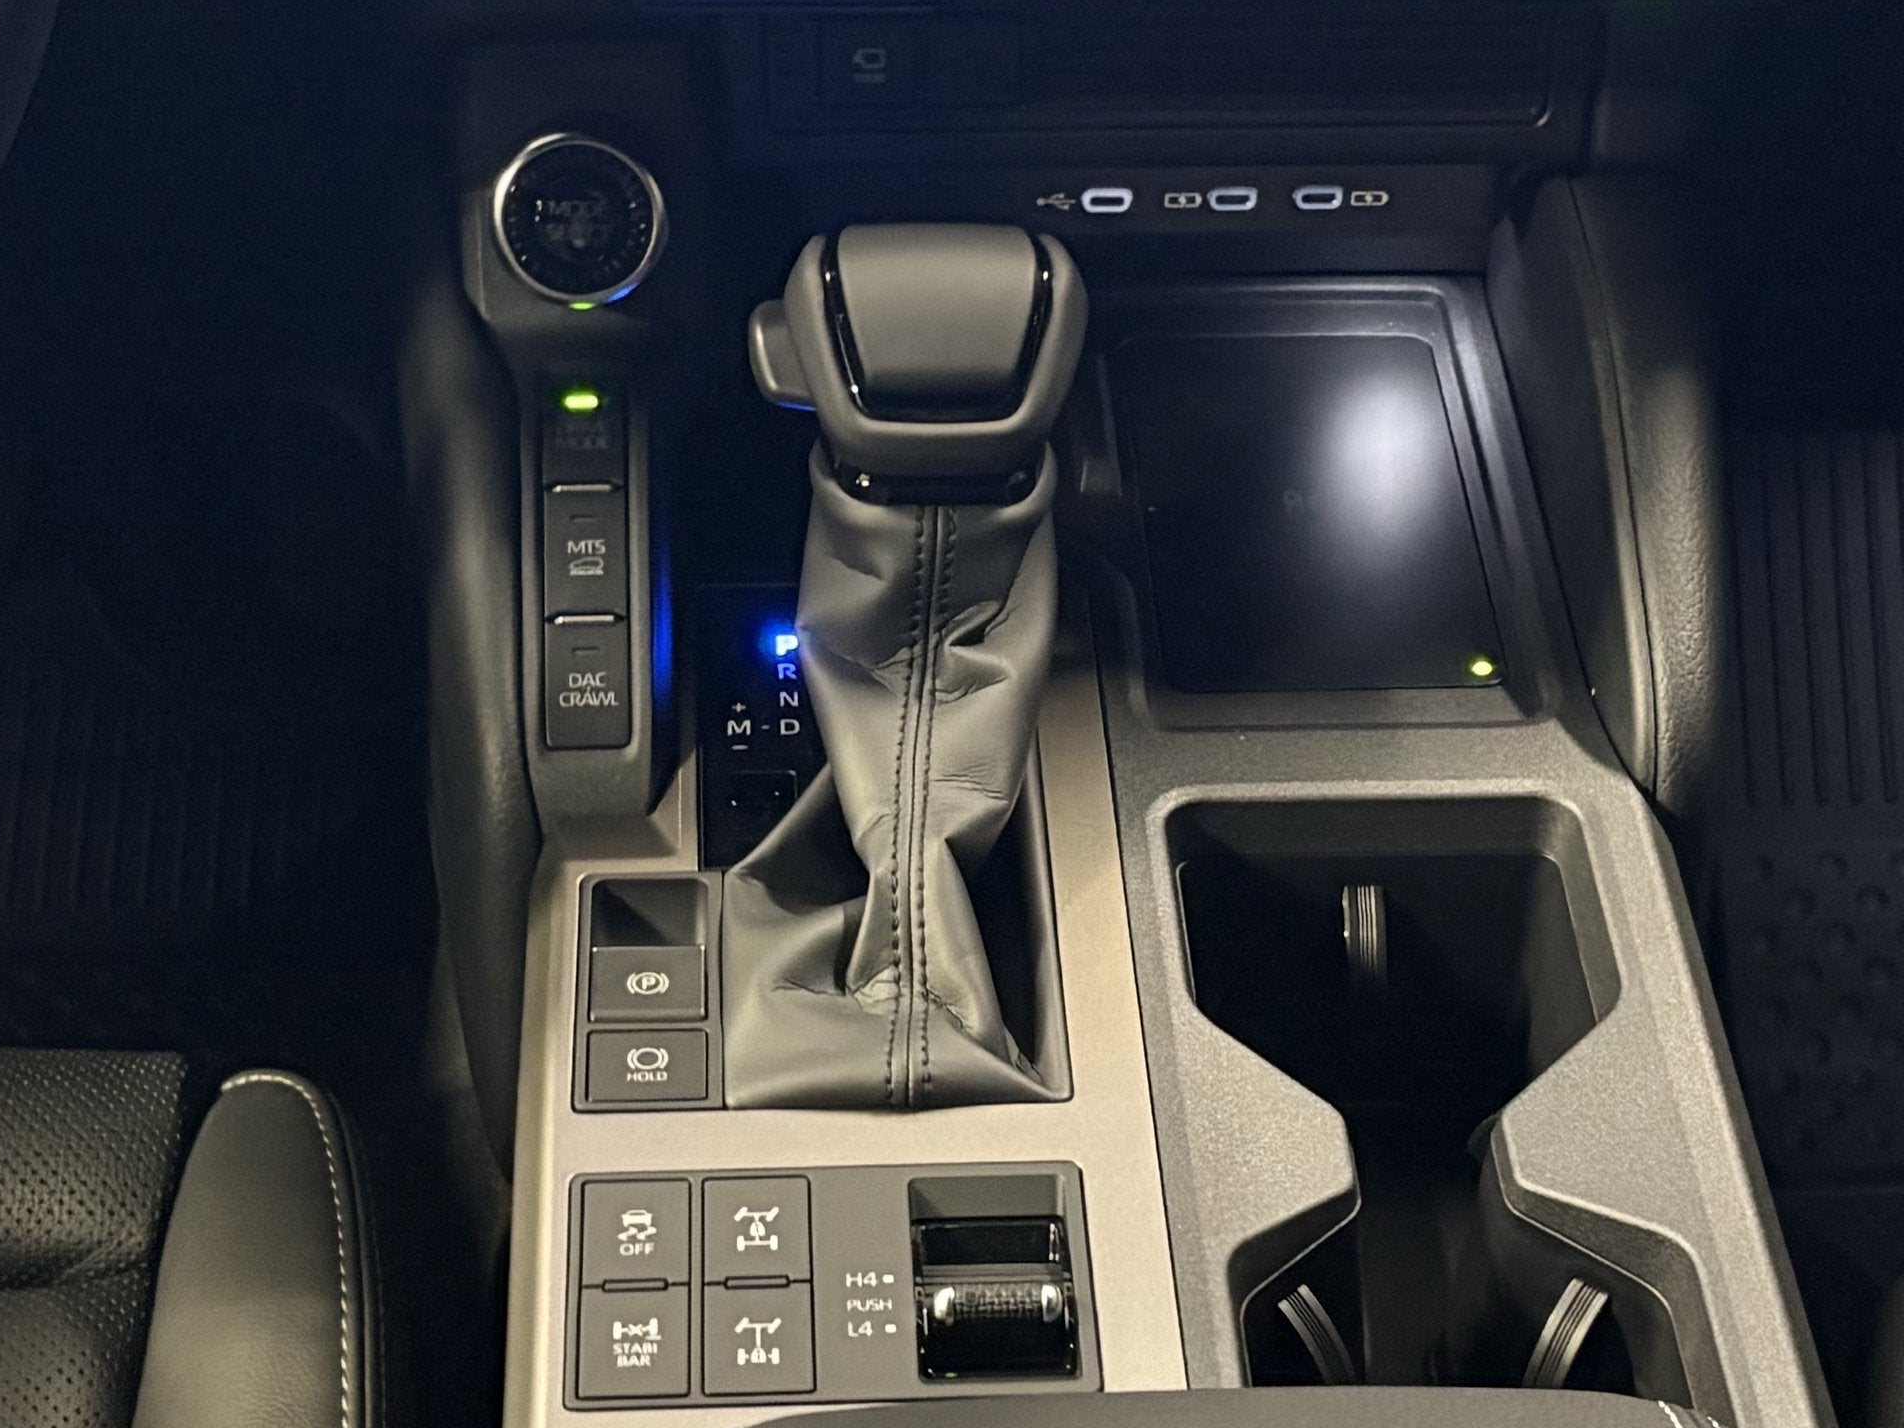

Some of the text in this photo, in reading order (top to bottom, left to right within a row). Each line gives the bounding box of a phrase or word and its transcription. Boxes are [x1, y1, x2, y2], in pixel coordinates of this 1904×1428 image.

[566, 539, 606, 556] MTS
[776, 634, 799, 657] P
[777, 662, 798, 680] R
[568, 671, 606, 689] DAC
[558, 690, 619, 707] CRAWL
[779, 691, 799, 707] N
[780, 718, 800, 735] D
[627, 1070, 669, 1083] HOLD
[619, 1242, 656, 1258] OFF
[845, 1271, 879, 1288] H4
[846, 1297, 893, 1312] PUSH
[847, 1322, 873, 1338] L4
[612, 1341, 659, 1356] STABI
[616, 1352, 652, 1368] BAR
